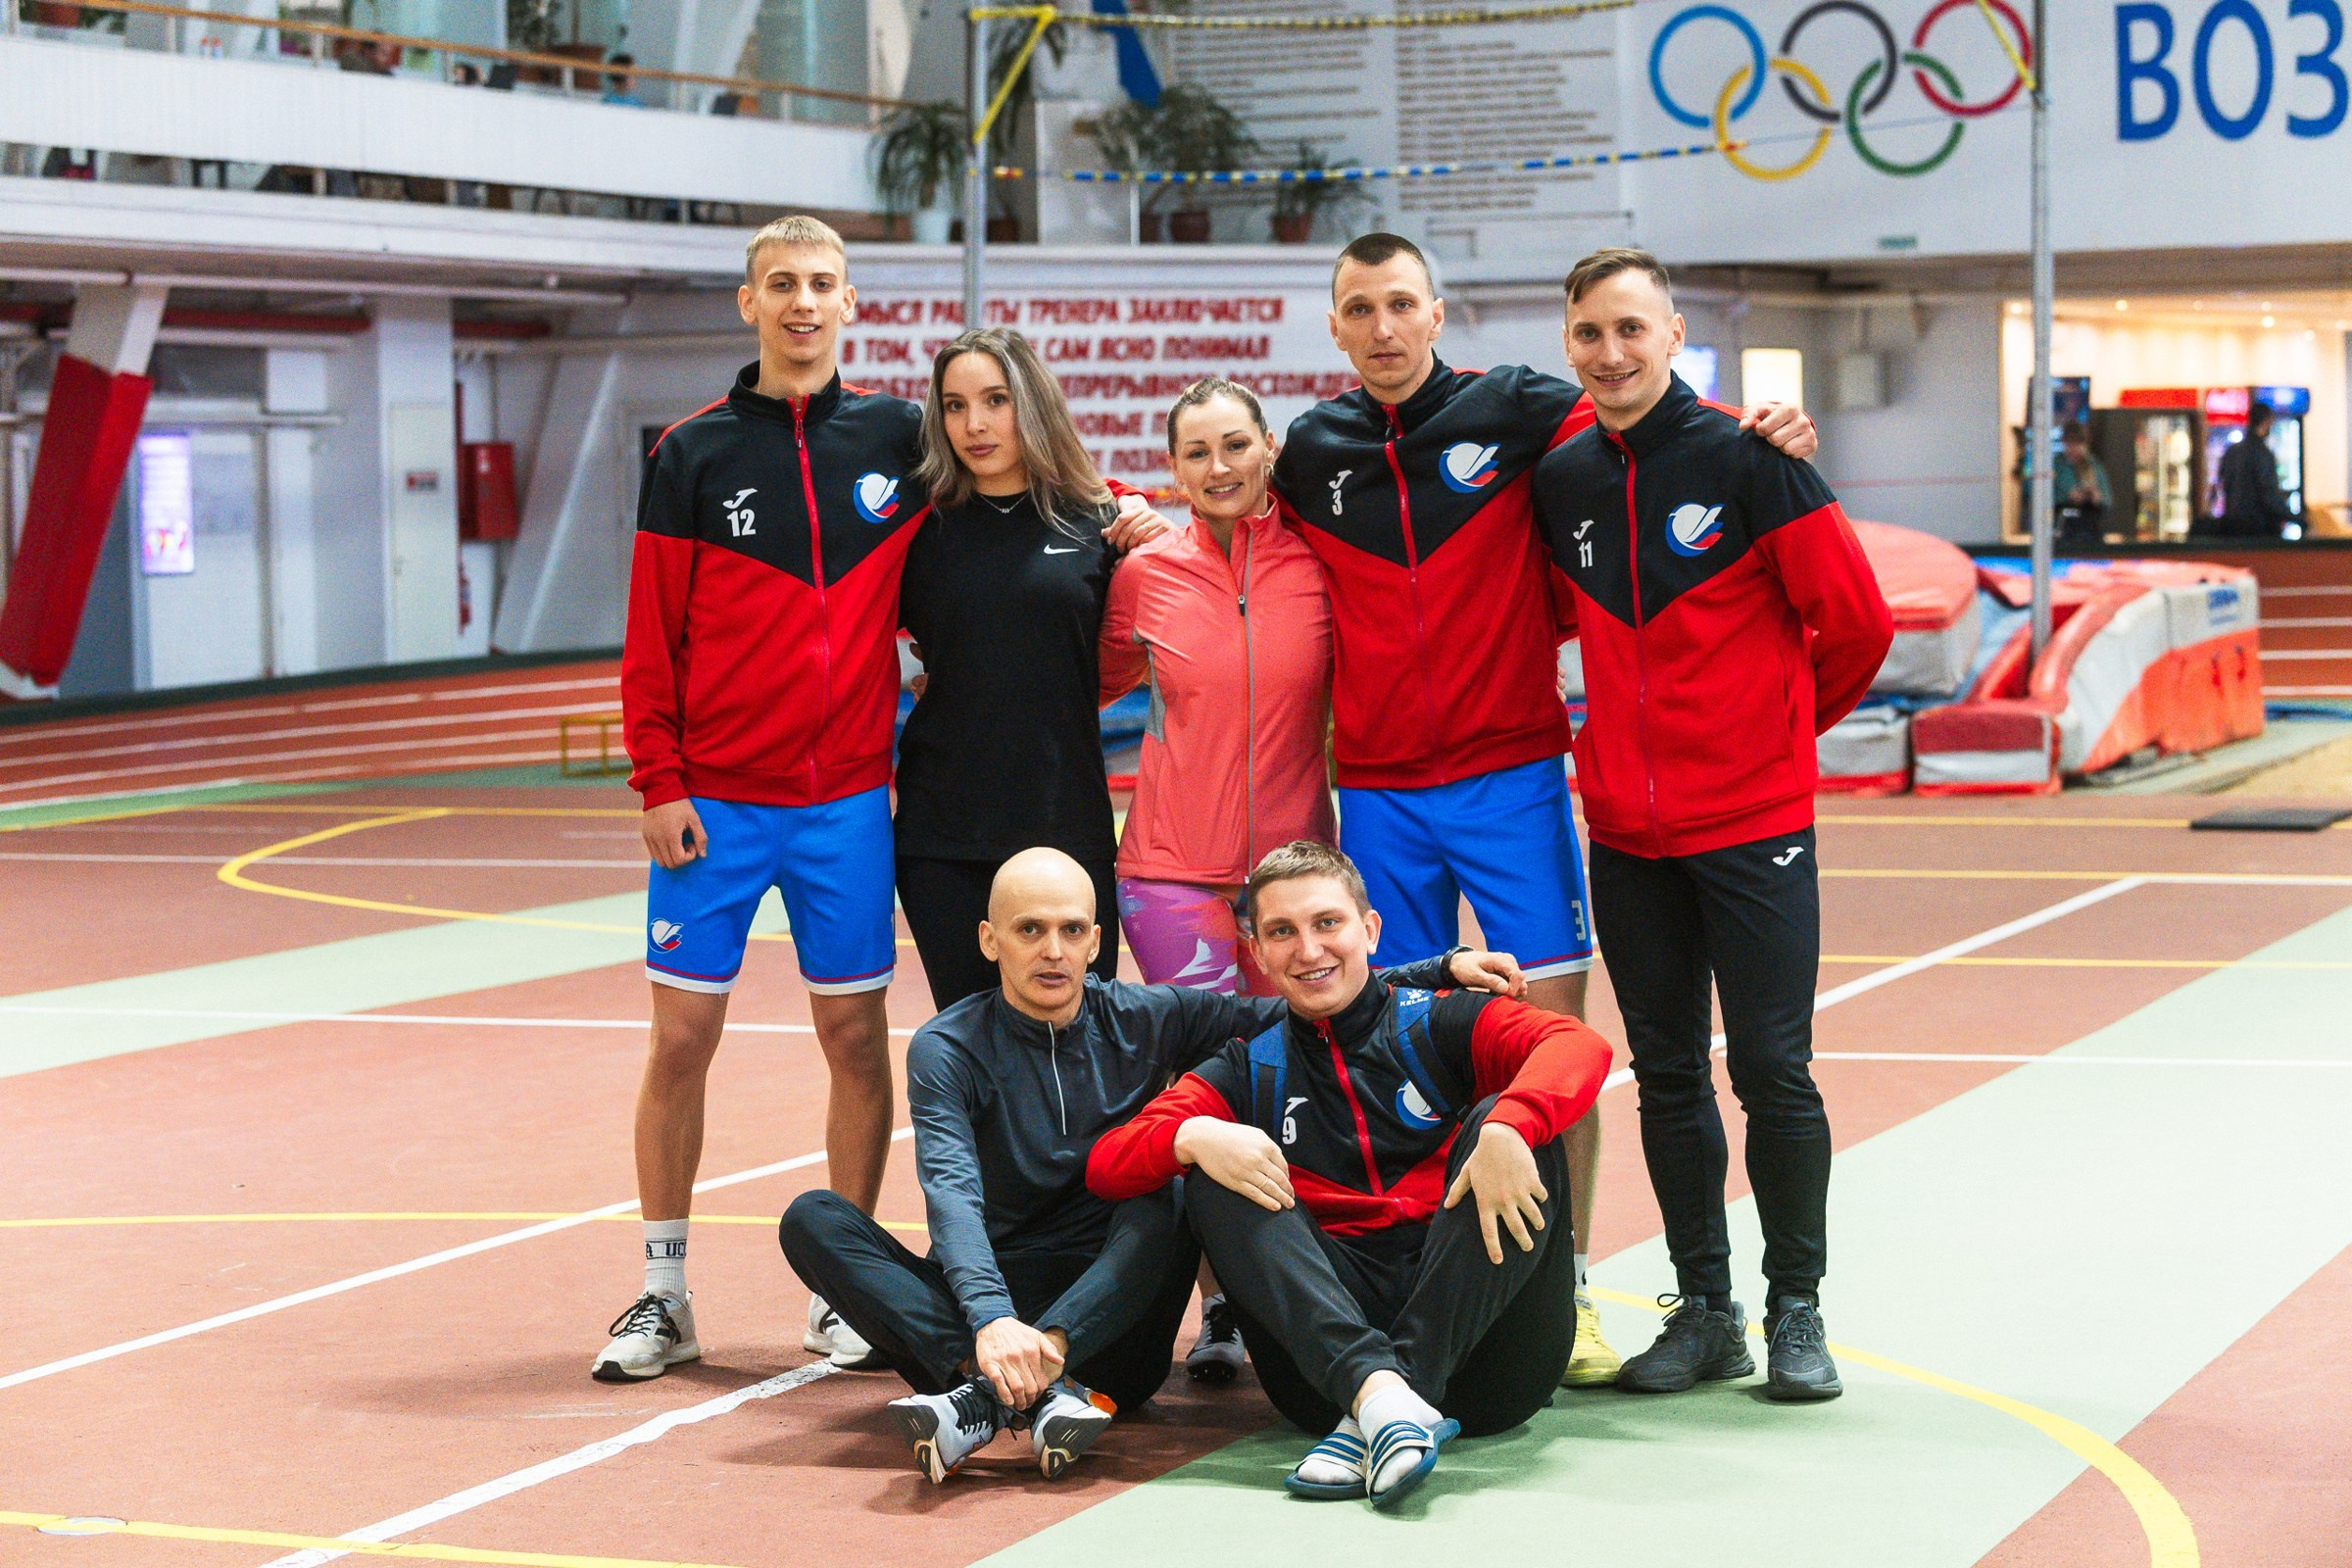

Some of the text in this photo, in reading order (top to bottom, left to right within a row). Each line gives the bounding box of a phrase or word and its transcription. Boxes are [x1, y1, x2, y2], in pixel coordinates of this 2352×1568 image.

[2115, 0, 2349, 142] ВОЗ
[847, 300, 923, 324] МЫСЛ
[1029, 298, 1119, 322] ТРЕНЕРА
[1128, 298, 1284, 323] ЗАКЛЮЧАЕТСЯ
[1045, 337, 1090, 362] САМ
[1098, 337, 1154, 361] ЯСНО
[1162, 335, 1269, 360] ПОНИМАЛ
[1331, 489, 1344, 516] 3
[726, 508, 757, 537] 12
[1578, 540, 1593, 568] 11
[1399, 996, 1430, 1006] KELME
[1282, 1116, 1298, 1146] 9
